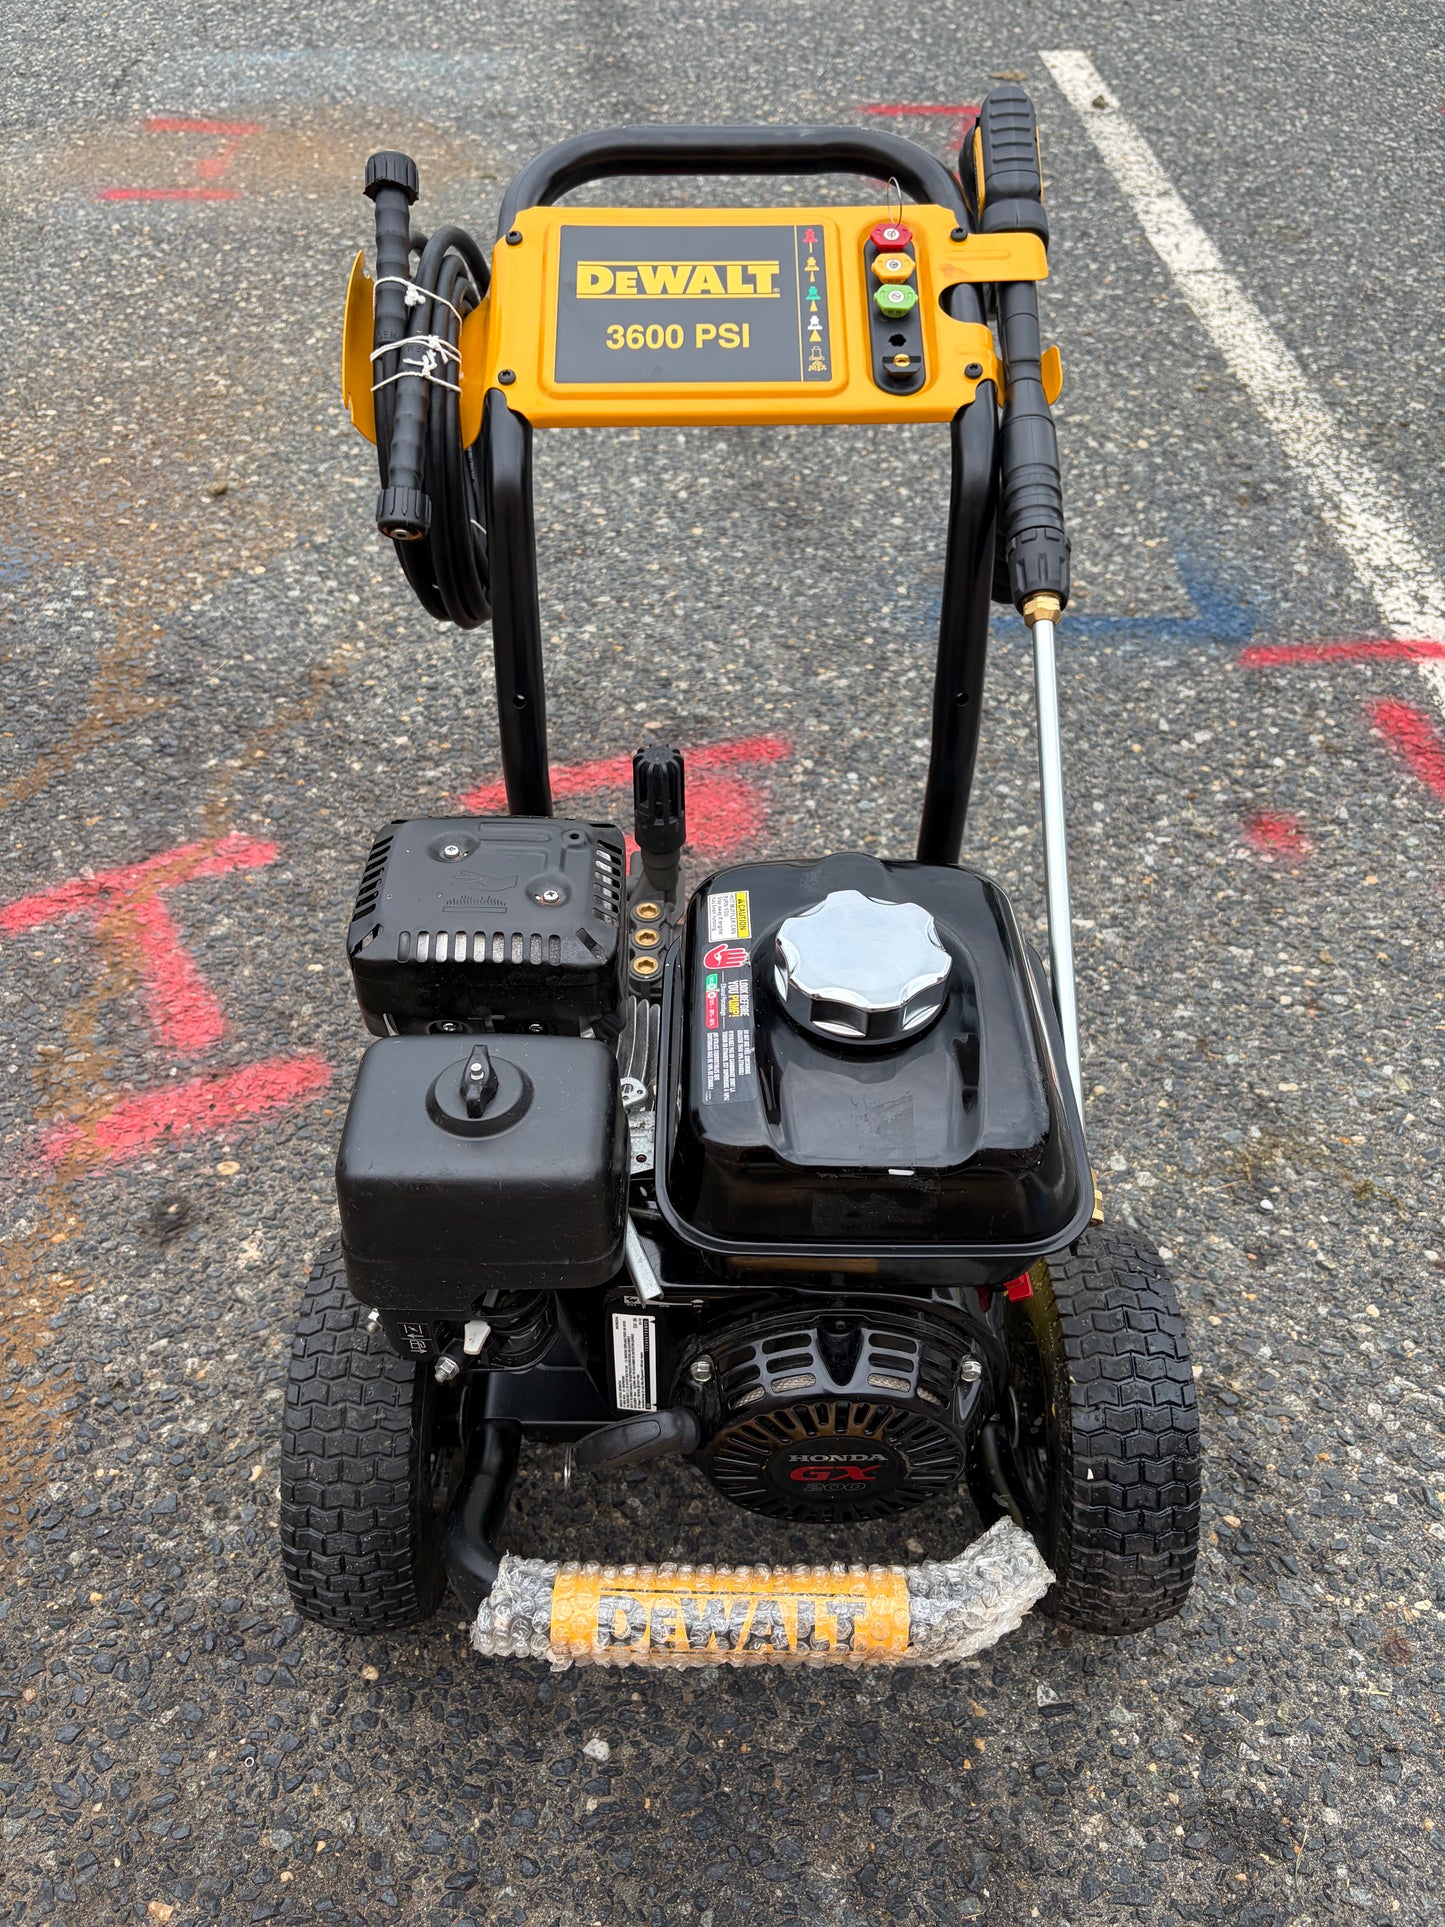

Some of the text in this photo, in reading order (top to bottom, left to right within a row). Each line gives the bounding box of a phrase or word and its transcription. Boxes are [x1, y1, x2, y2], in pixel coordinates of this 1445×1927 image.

[576, 264, 778, 295] DEWALT
[606, 323, 751, 350] 3600 PSI
[728, 980, 739, 994] YOU
[728, 995, 739, 1018] PUMP!
[740, 979, 750, 1017] LOOK BEFORE
[789, 1454, 888, 1462] HONDA
[790, 1466, 882, 1481] GX
[804, 1483, 866, 1492] 200
